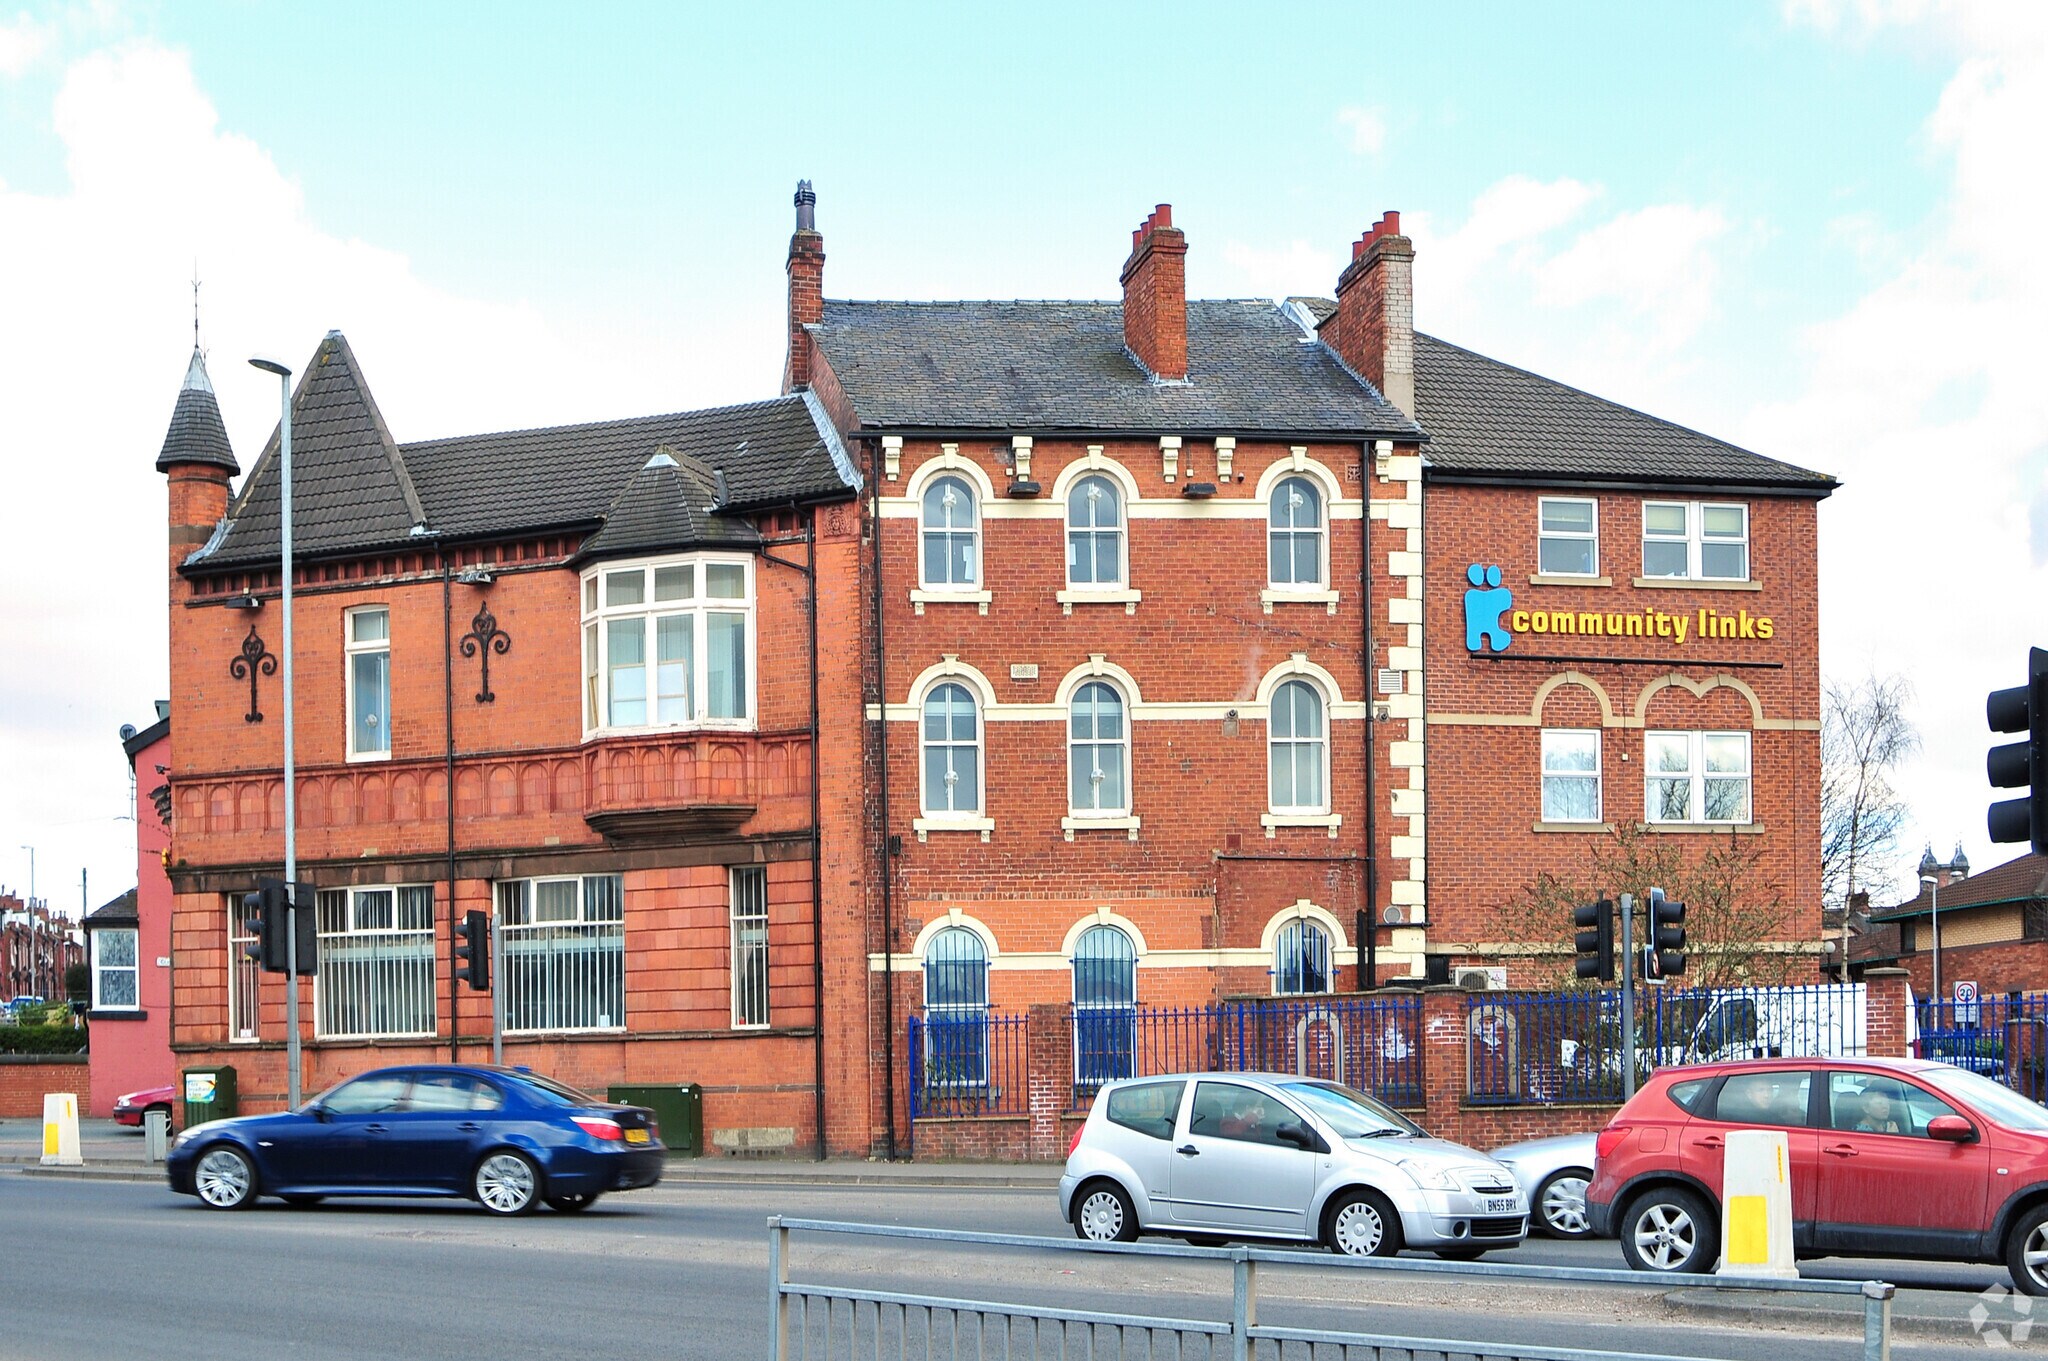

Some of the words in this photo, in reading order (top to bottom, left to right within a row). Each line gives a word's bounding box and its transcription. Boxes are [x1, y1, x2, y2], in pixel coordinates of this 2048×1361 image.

[1513, 607, 1689, 643] community
[1698, 609, 1774, 639] links
[1960, 988, 1972, 997] 20
[1488, 1200, 1504, 1211] BN55
